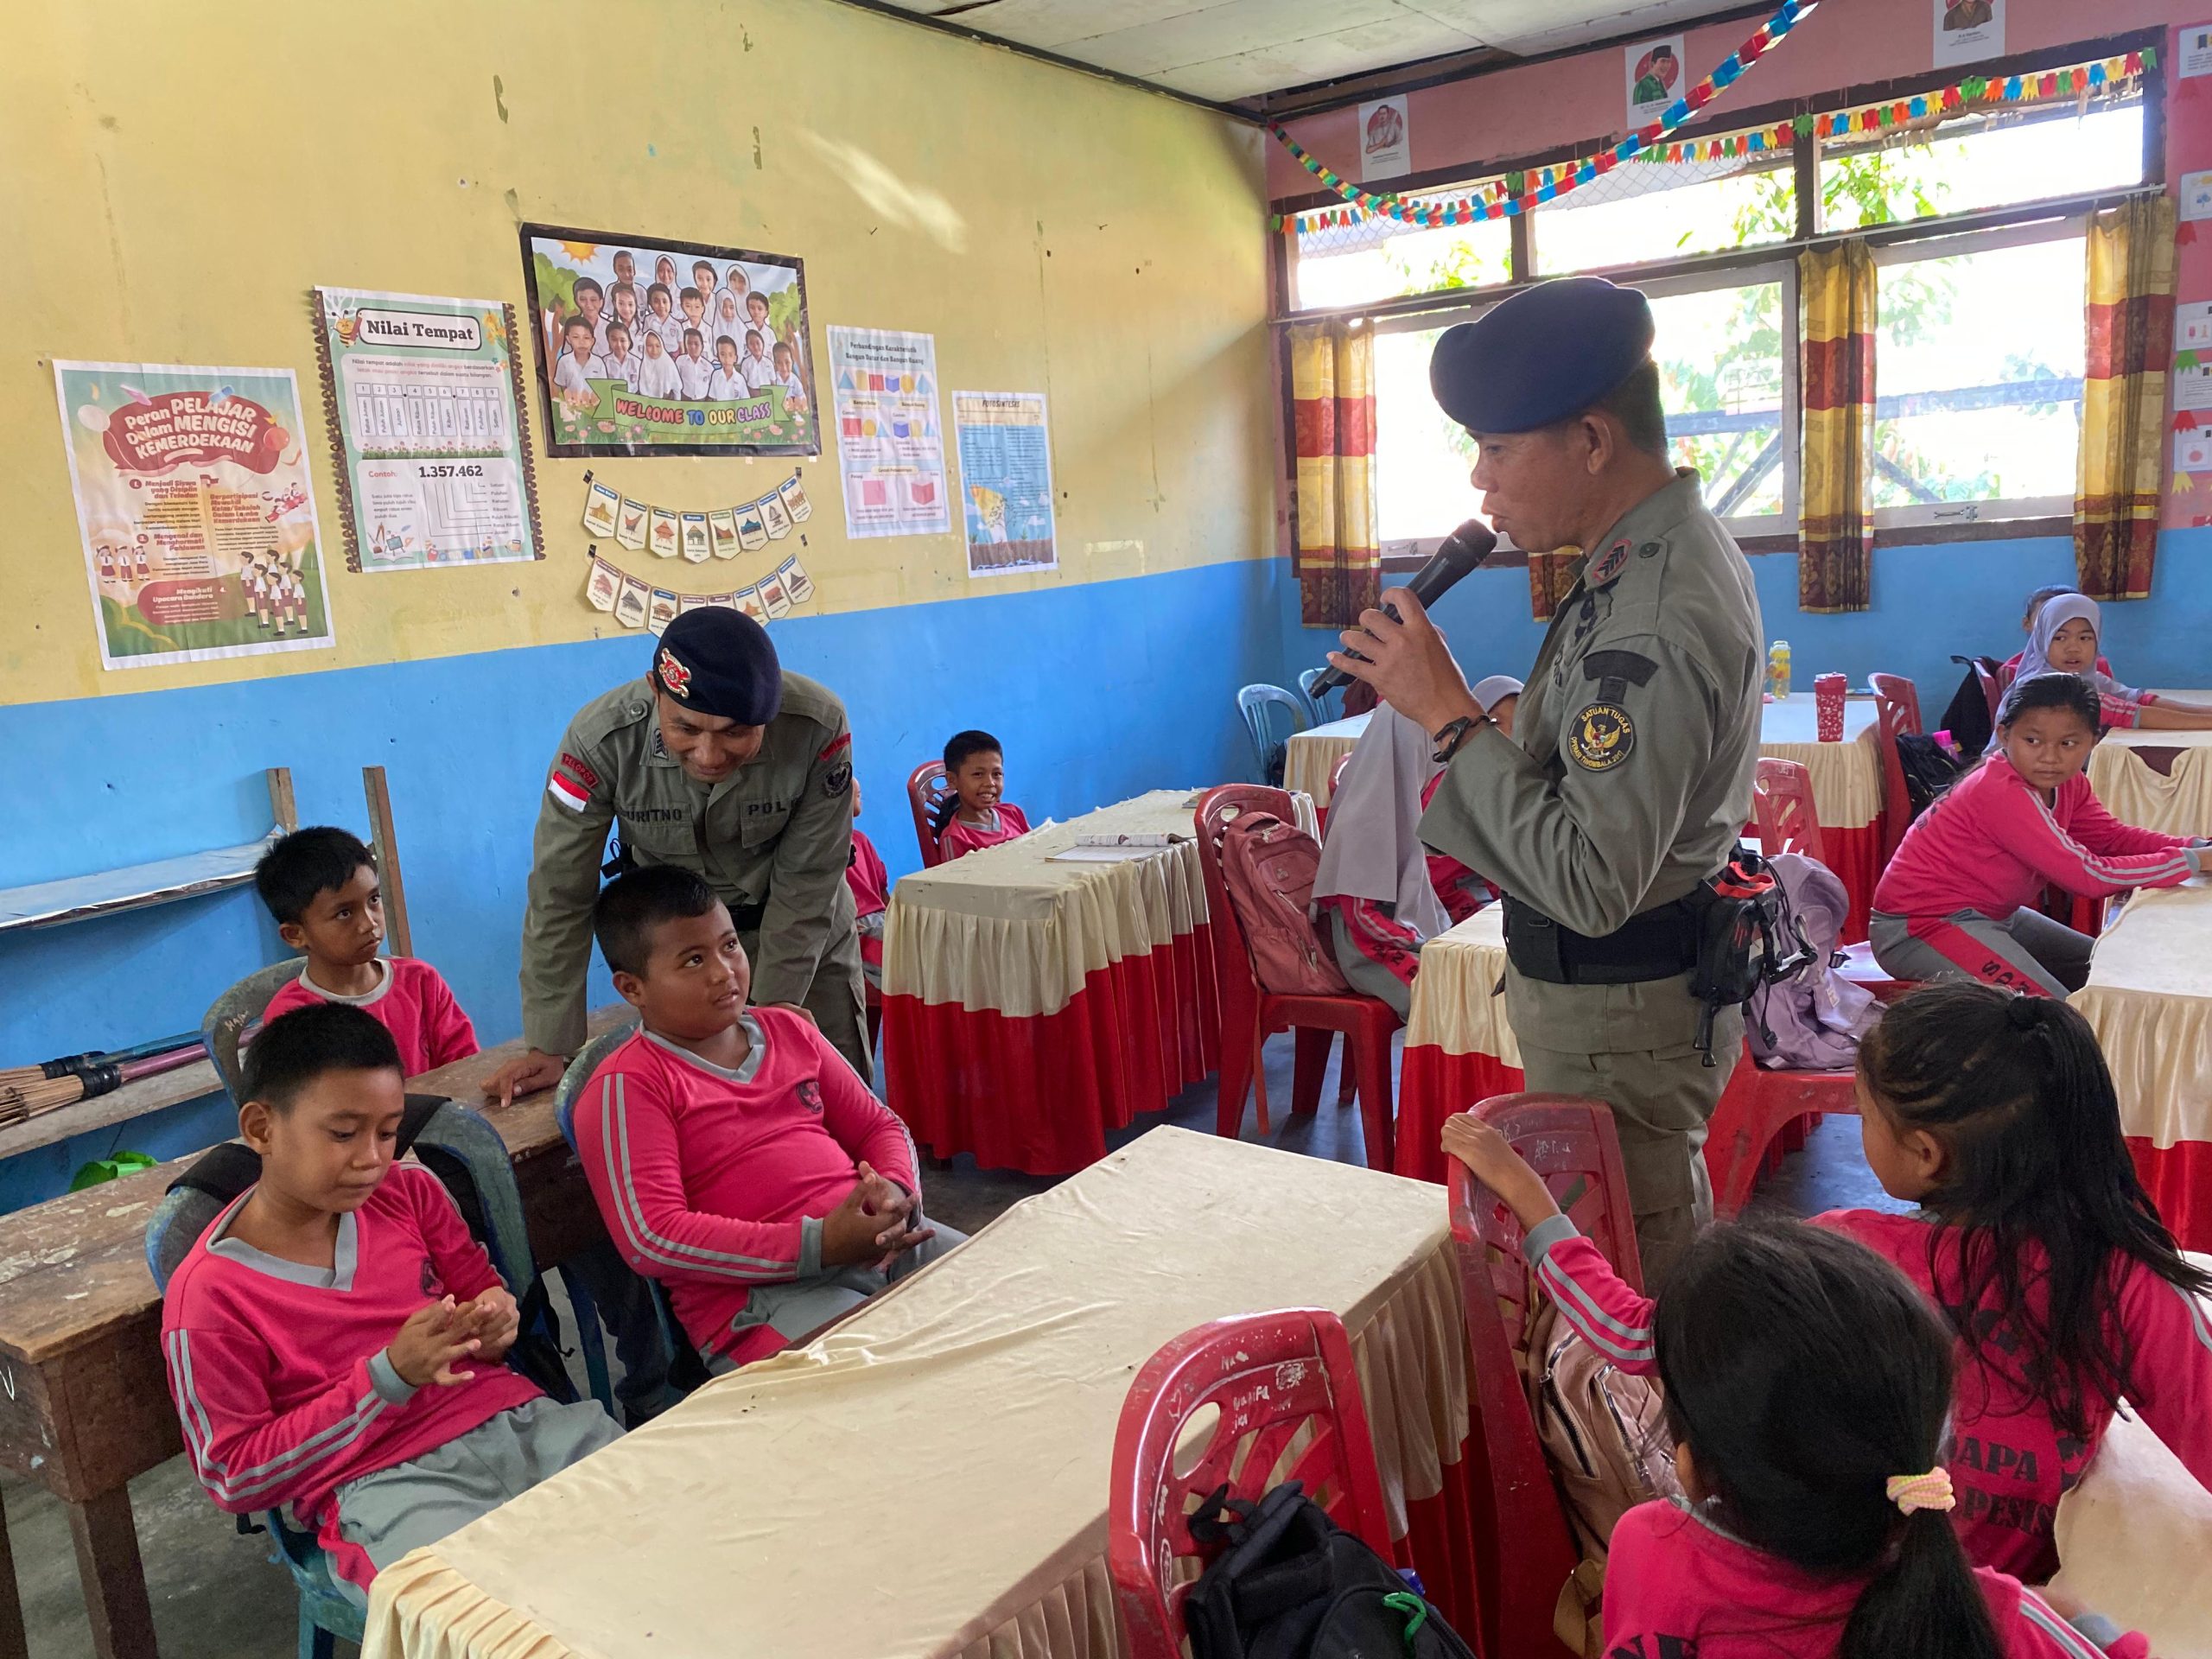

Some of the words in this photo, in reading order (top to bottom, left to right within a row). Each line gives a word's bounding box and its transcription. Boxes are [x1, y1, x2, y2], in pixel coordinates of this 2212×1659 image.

[366, 320, 409, 336] Nilai
[413, 323, 474, 342] Tempat
[124, 408, 170, 429] Peran
[170, 397, 257, 423] PELAJAR
[615, 398, 683, 424] WELCOME
[686, 410, 705, 426] TO
[709, 408, 736, 425] OUR
[736, 402, 772, 423] CLASS
[125, 423, 173, 445] Dalam
[174, 415, 257, 438] MENGISI
[135, 434, 255, 460] KEMERDEKAAN
[418, 465, 483, 478] 1.357.462
[176, 586, 213, 594] Mengikuti
[1581, 707, 1609, 722] SATUAN
[1609, 709, 1630, 734] TUGAS
[1571, 736, 1582, 760] OPERASI
[564, 755, 594, 783] PELOPOR
